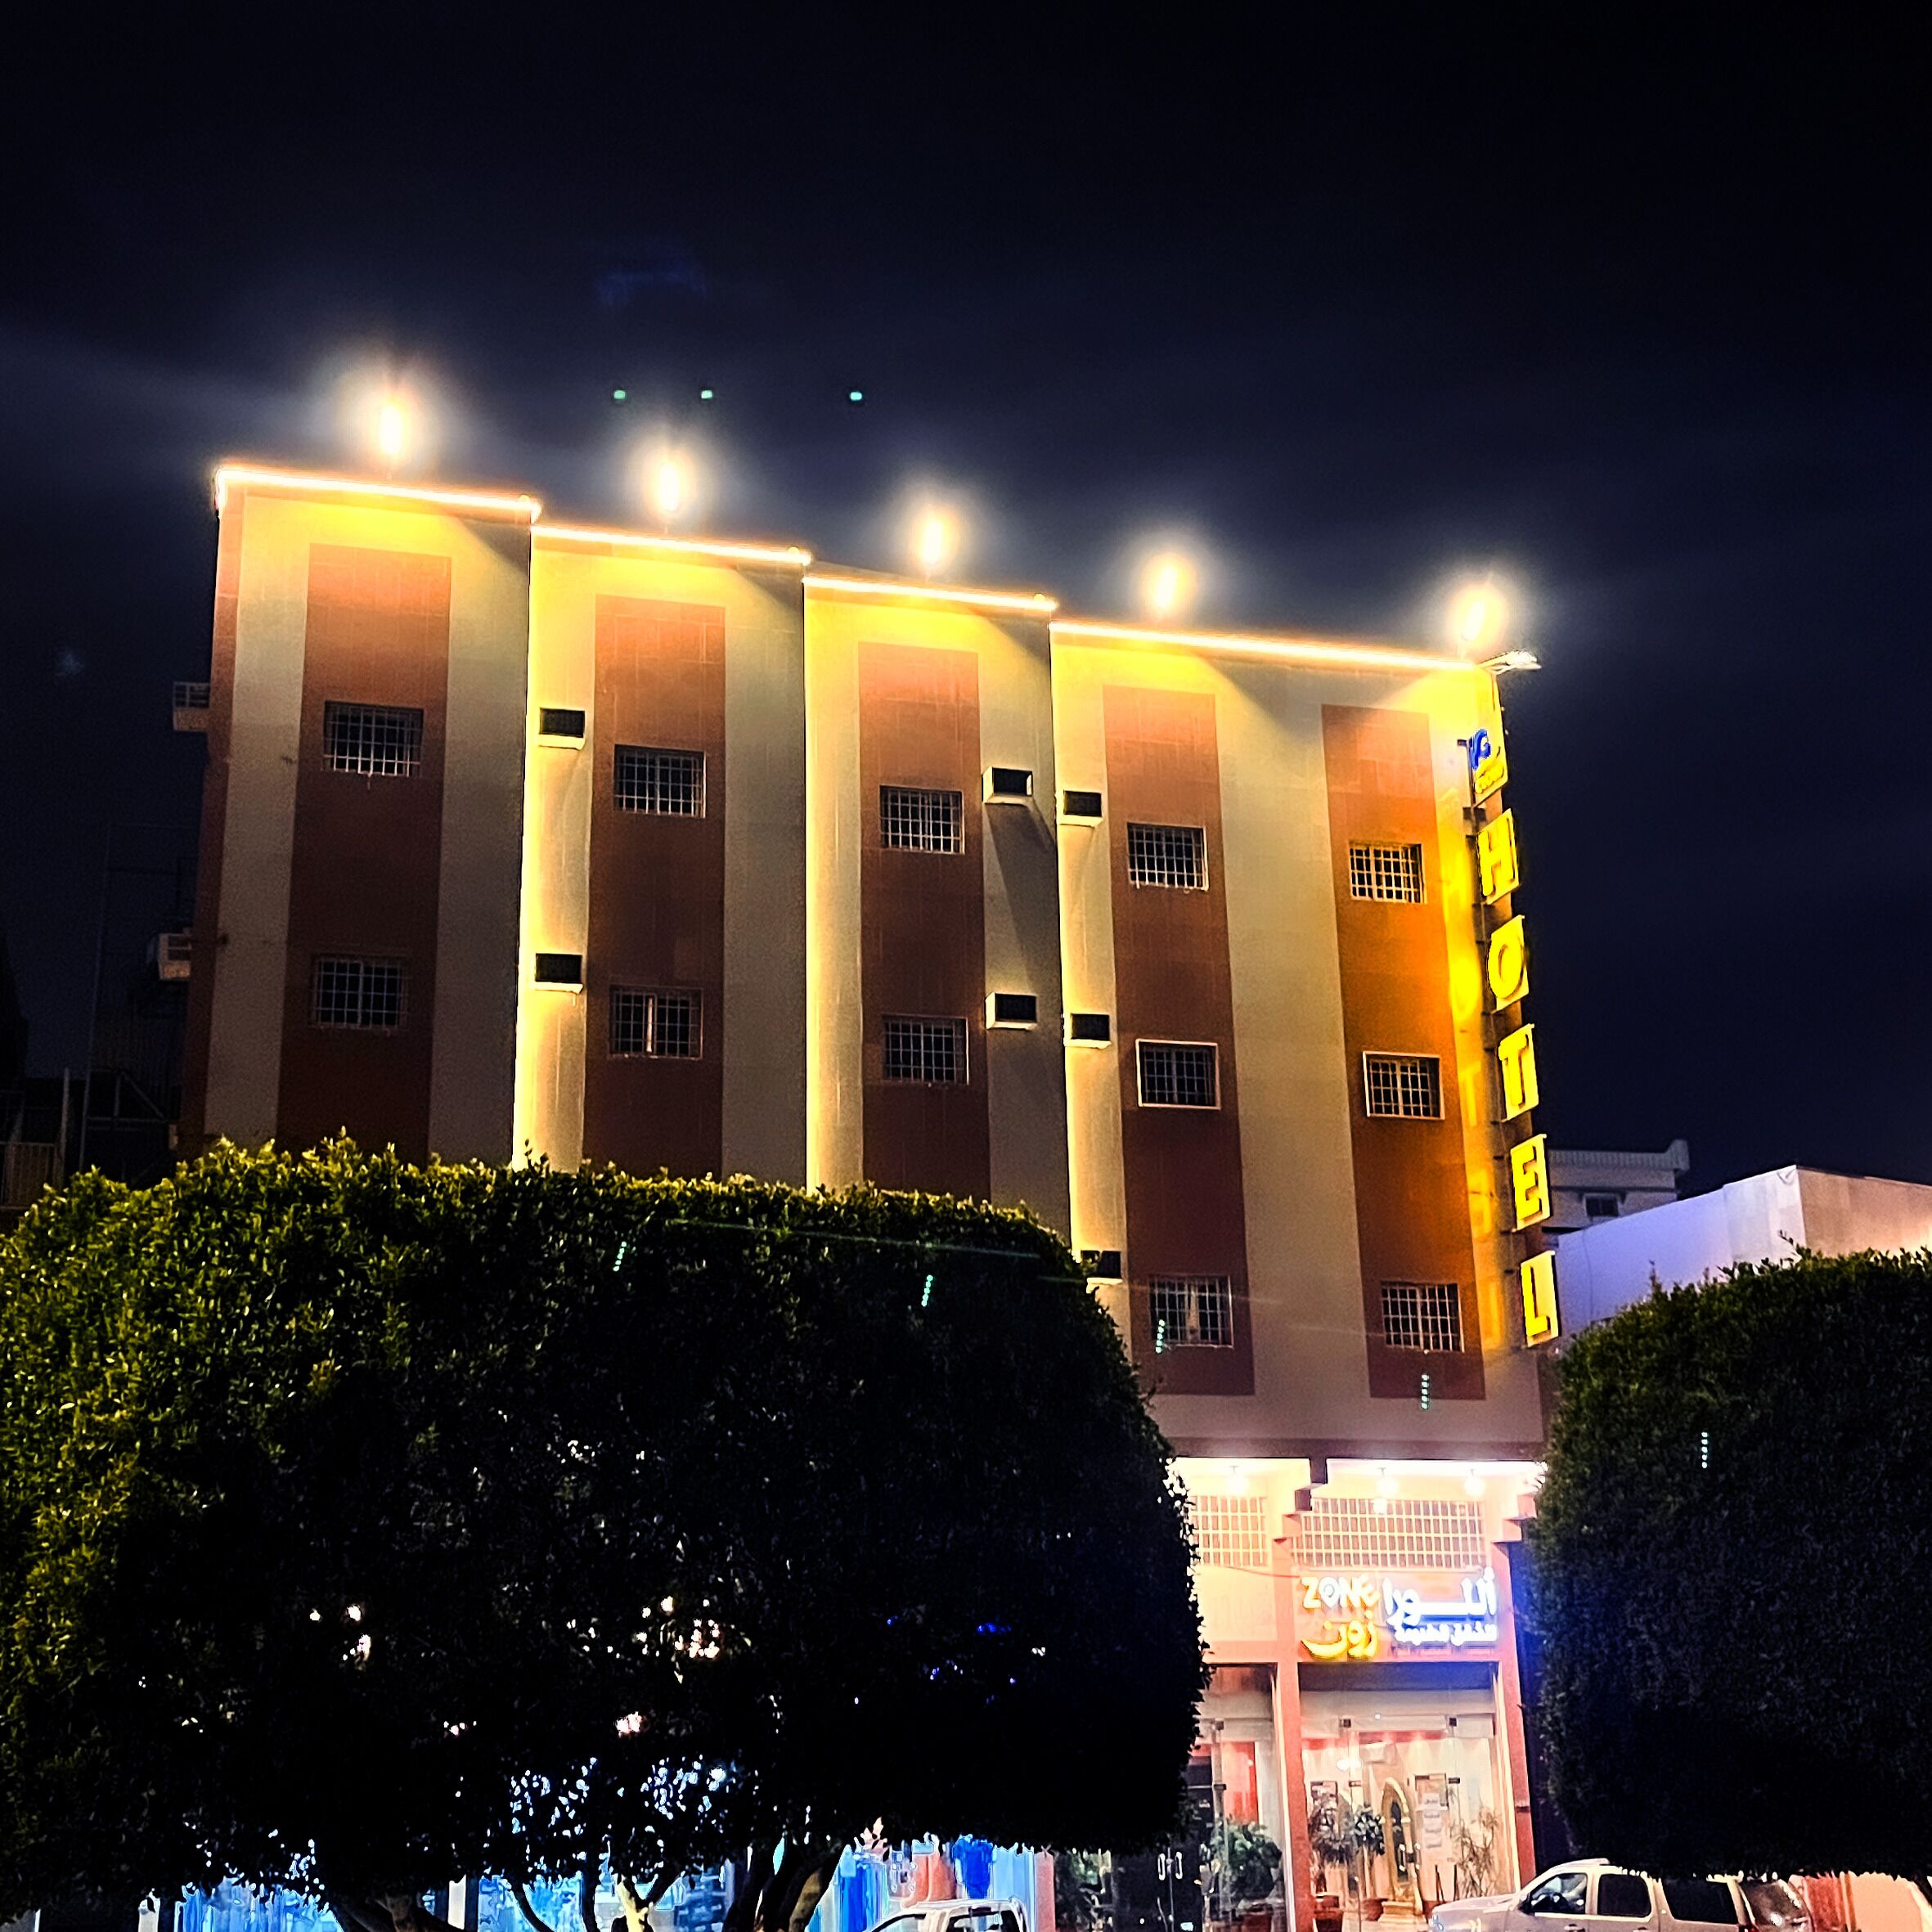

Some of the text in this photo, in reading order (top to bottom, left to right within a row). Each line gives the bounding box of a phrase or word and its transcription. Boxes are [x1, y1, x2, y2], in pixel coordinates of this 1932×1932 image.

[1477, 816, 1550, 1337] HOTEL
[1301, 1573, 1380, 1609] ZONE
[1301, 1610, 1377, 1658] زون
